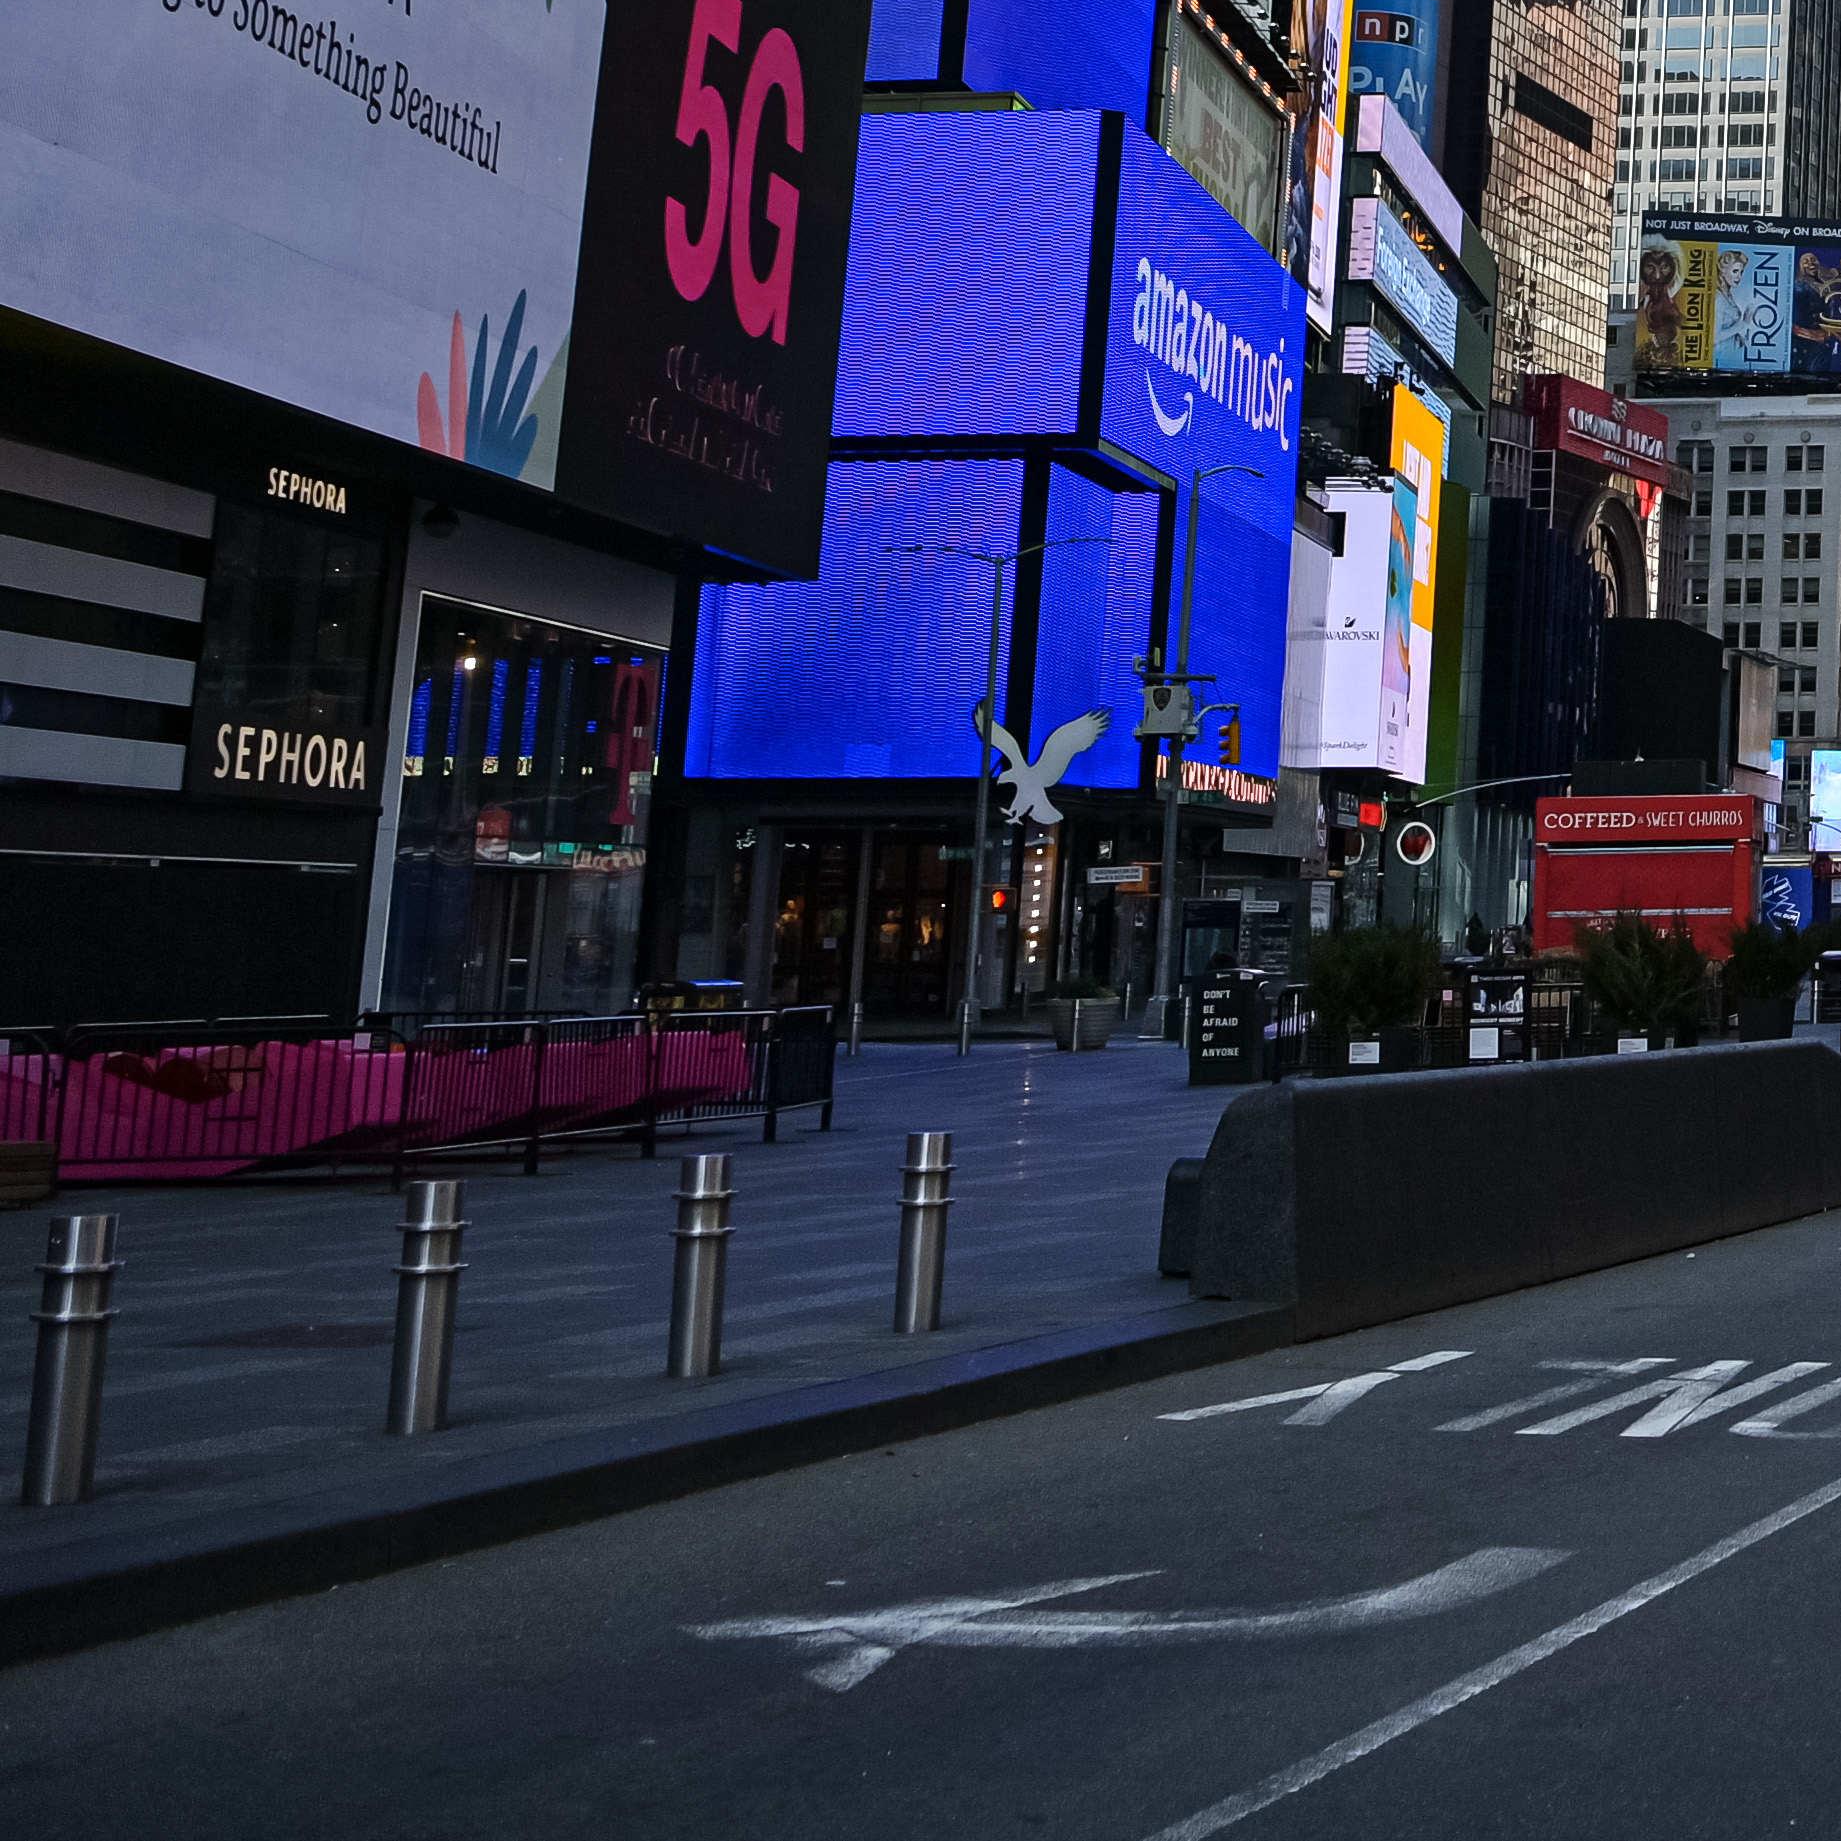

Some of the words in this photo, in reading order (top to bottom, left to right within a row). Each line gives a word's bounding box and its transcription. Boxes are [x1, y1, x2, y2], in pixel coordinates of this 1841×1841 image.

[1364, 16, 1426, 48] npr
[390, 59, 503, 176] Beautiful
[1645, 219, 1667, 230] NOT
[1670, 220, 1692, 230] JUST
[1694, 221, 1750, 233] BROADWAY,
[1753, 220, 1791, 238] Disney
[1793, 226, 1810, 237] ON
[1683, 248, 1703, 289] KING
[1681, 292, 1702, 331] LION
[1743, 251, 1785, 363] FROZEN
[1132, 256, 1227, 406] amazon
[1227, 337, 1293, 452] music
[1684, 335, 1699, 363] THE
[267, 467, 348, 516] SEPHORA
[213, 723, 367, 792] SEPHORA
[1544, 813, 1636, 829] COFFEED
[1646, 811, 1684, 827] SWEET
[1688, 810, 1744, 827] CHURROS
[1202, 1017, 1239, 1027] AFRAID
[1202, 1047, 1240, 1057] ANYONE
